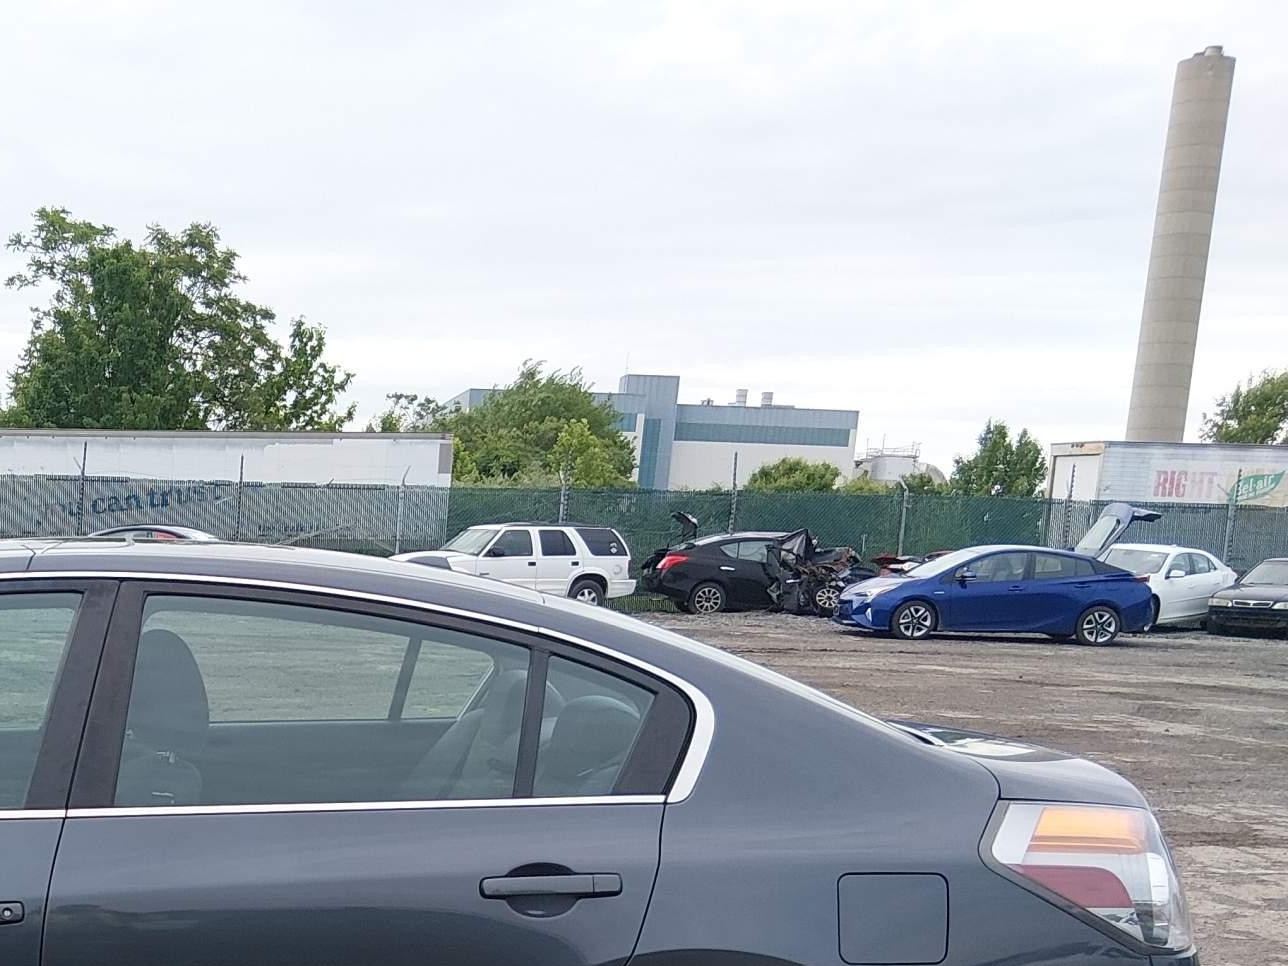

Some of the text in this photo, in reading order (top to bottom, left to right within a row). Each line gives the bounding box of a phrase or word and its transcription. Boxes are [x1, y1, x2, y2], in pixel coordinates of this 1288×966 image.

[91, 490, 145, 516] can
[148, 482, 227, 509] trust
[1153, 469, 1218, 498] RIGHT
